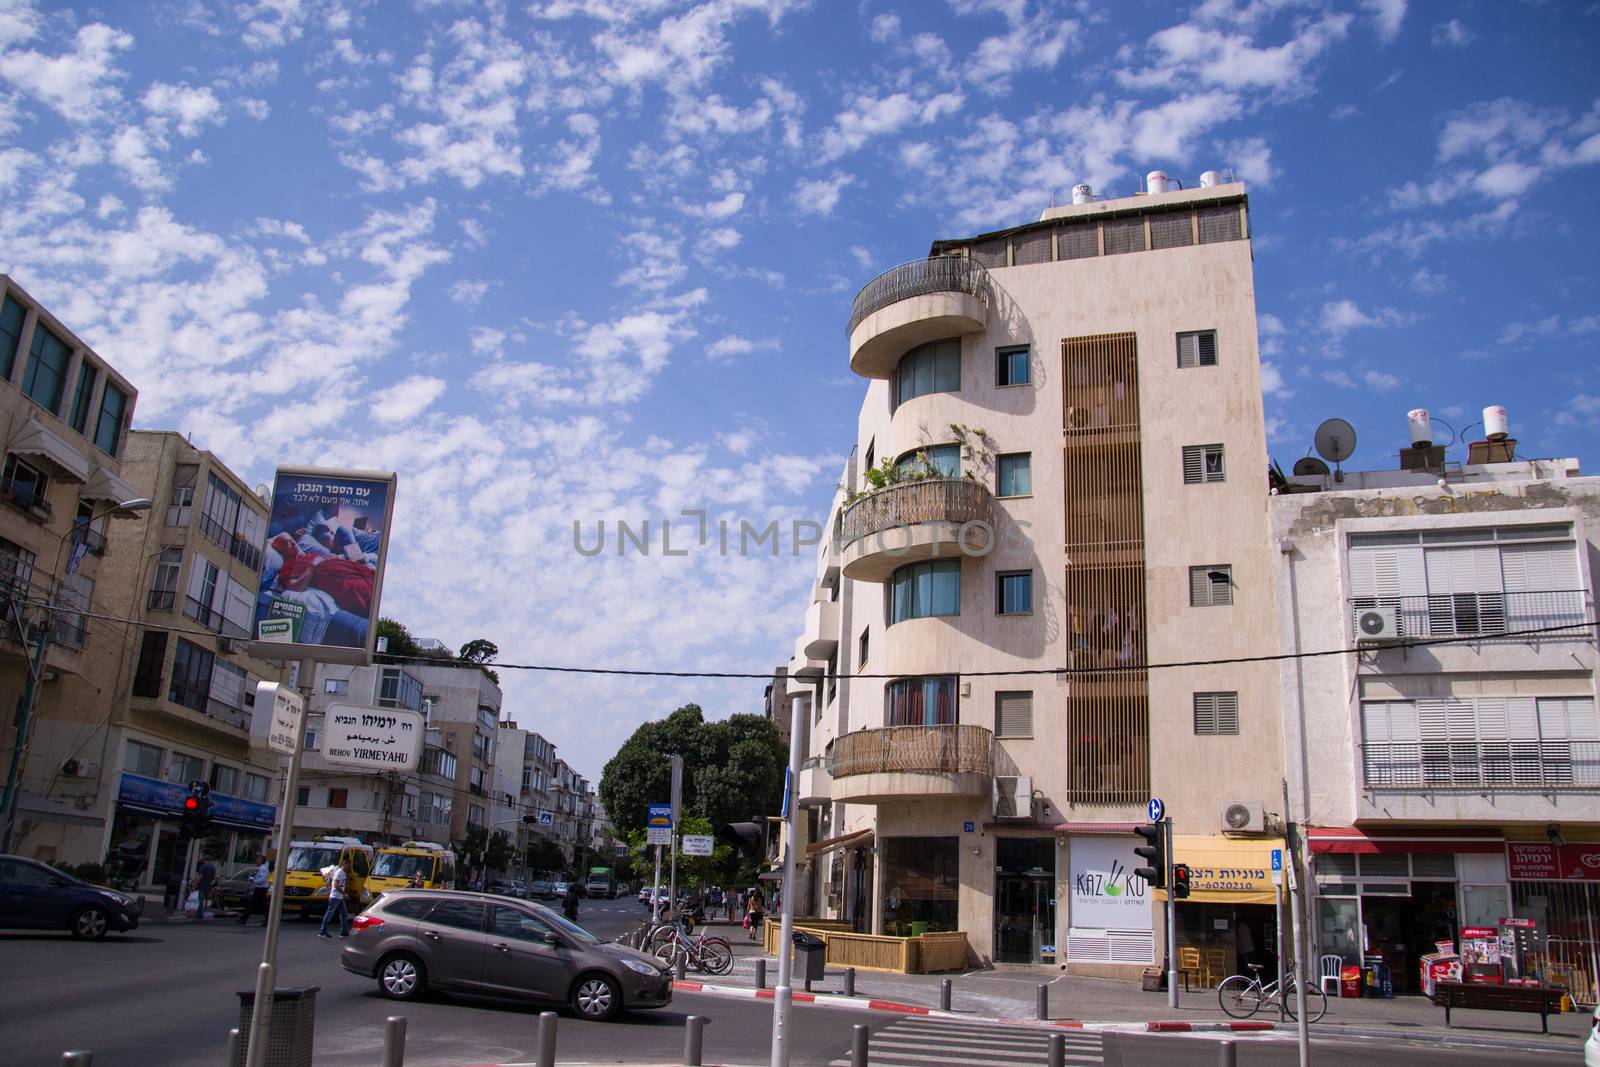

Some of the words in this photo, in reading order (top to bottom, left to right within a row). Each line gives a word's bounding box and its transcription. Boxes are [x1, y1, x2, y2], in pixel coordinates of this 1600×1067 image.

[325, 485, 354, 495] הספר
[355, 487, 371, 497] עם
[308, 494, 320, 503] לא
[352, 498, 370, 506] אתה
[273, 602, 303, 613] מומחים
[334, 715, 357, 725] הנביא
[362, 714, 397, 728] ירמיהו
[329, 747, 352, 757] REHOV
[353, 747, 409, 763] YIRMEYAHU
[1516, 853, 1553, 863] ירמיהו
[1219, 869, 1265, 879] מוניות
